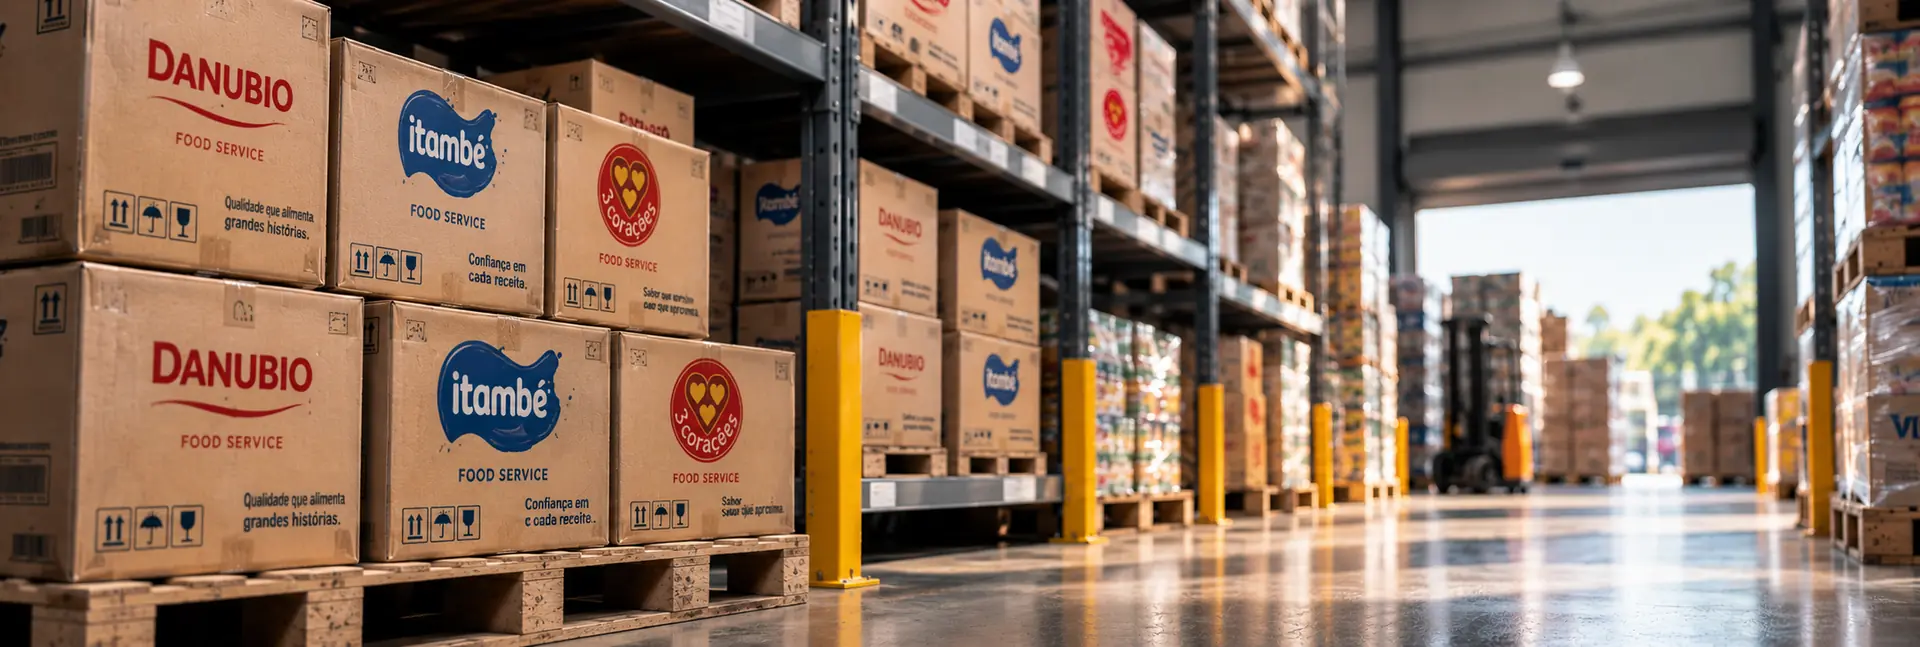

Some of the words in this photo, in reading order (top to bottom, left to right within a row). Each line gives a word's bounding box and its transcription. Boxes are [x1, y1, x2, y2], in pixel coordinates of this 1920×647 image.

[148, 38, 293, 112] DANUBIO
[176, 132, 211, 150] FOOD
[216, 140, 264, 162] SERVICE
[409, 115, 486, 170] itambé
[602, 188, 614, 204] 3
[224, 195, 265, 214] Qualidade
[266, 205, 280, 219] que
[281, 206, 315, 223] alimenta
[410, 204, 441, 221] FOOD
[444, 211, 486, 230] SERVICE
[224, 217, 265, 233] grandes
[878, 206, 923, 238] DANUBIO
[468, 252, 511, 272] Confiança
[513, 262, 526, 273] em
[599, 253, 623, 267] FOOD
[625, 257, 658, 273] SERVICE
[468, 271, 492, 285] cada
[152, 341, 313, 393] DANUBIO
[879, 347, 925, 372] DANUBIO
[452, 370, 548, 418] itambé
[674, 408, 689, 425] 3
[181, 434, 221, 449] FOOD
[227, 435, 284, 450] SERVICE
[458, 468, 495, 483] FOOD
[499, 468, 549, 482] SERVICE
[673, 473, 700, 484] FOOD
[703, 472, 740, 484] SERVICE
[243, 492, 290, 511] Qualidade
[291, 494, 308, 509] que
[309, 492, 346, 505] alimenta
[525, 496, 573, 512] Confiança
[575, 498, 589, 509] em
[243, 511, 289, 533] grandes
[292, 510, 341, 527] histórias.
